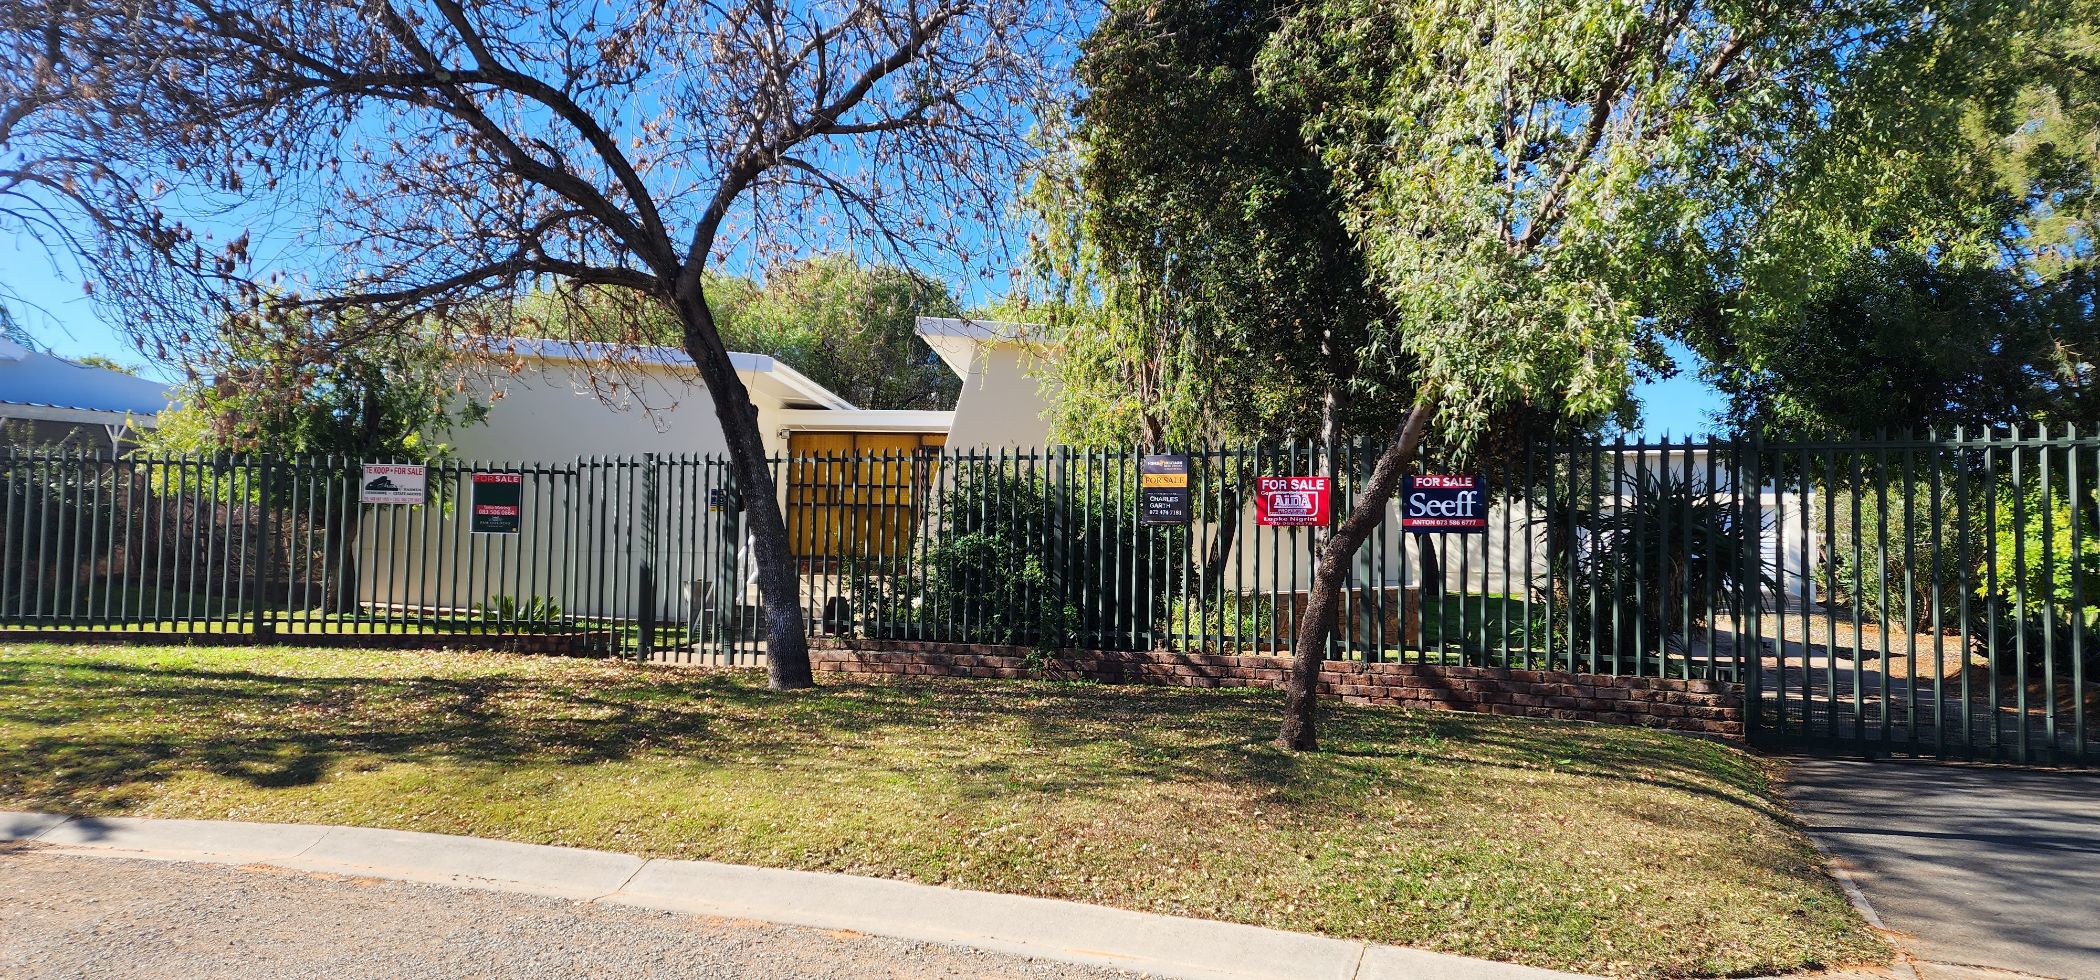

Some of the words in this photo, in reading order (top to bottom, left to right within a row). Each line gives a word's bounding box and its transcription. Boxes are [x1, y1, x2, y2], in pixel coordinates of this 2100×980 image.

[1262, 480, 1286, 489] FOR
[1291, 480, 1324, 490] SALE
[1416, 478, 1440, 486] FOR
[1443, 478, 1472, 486] SALE
[1410, 491, 1477, 516] Seeff
